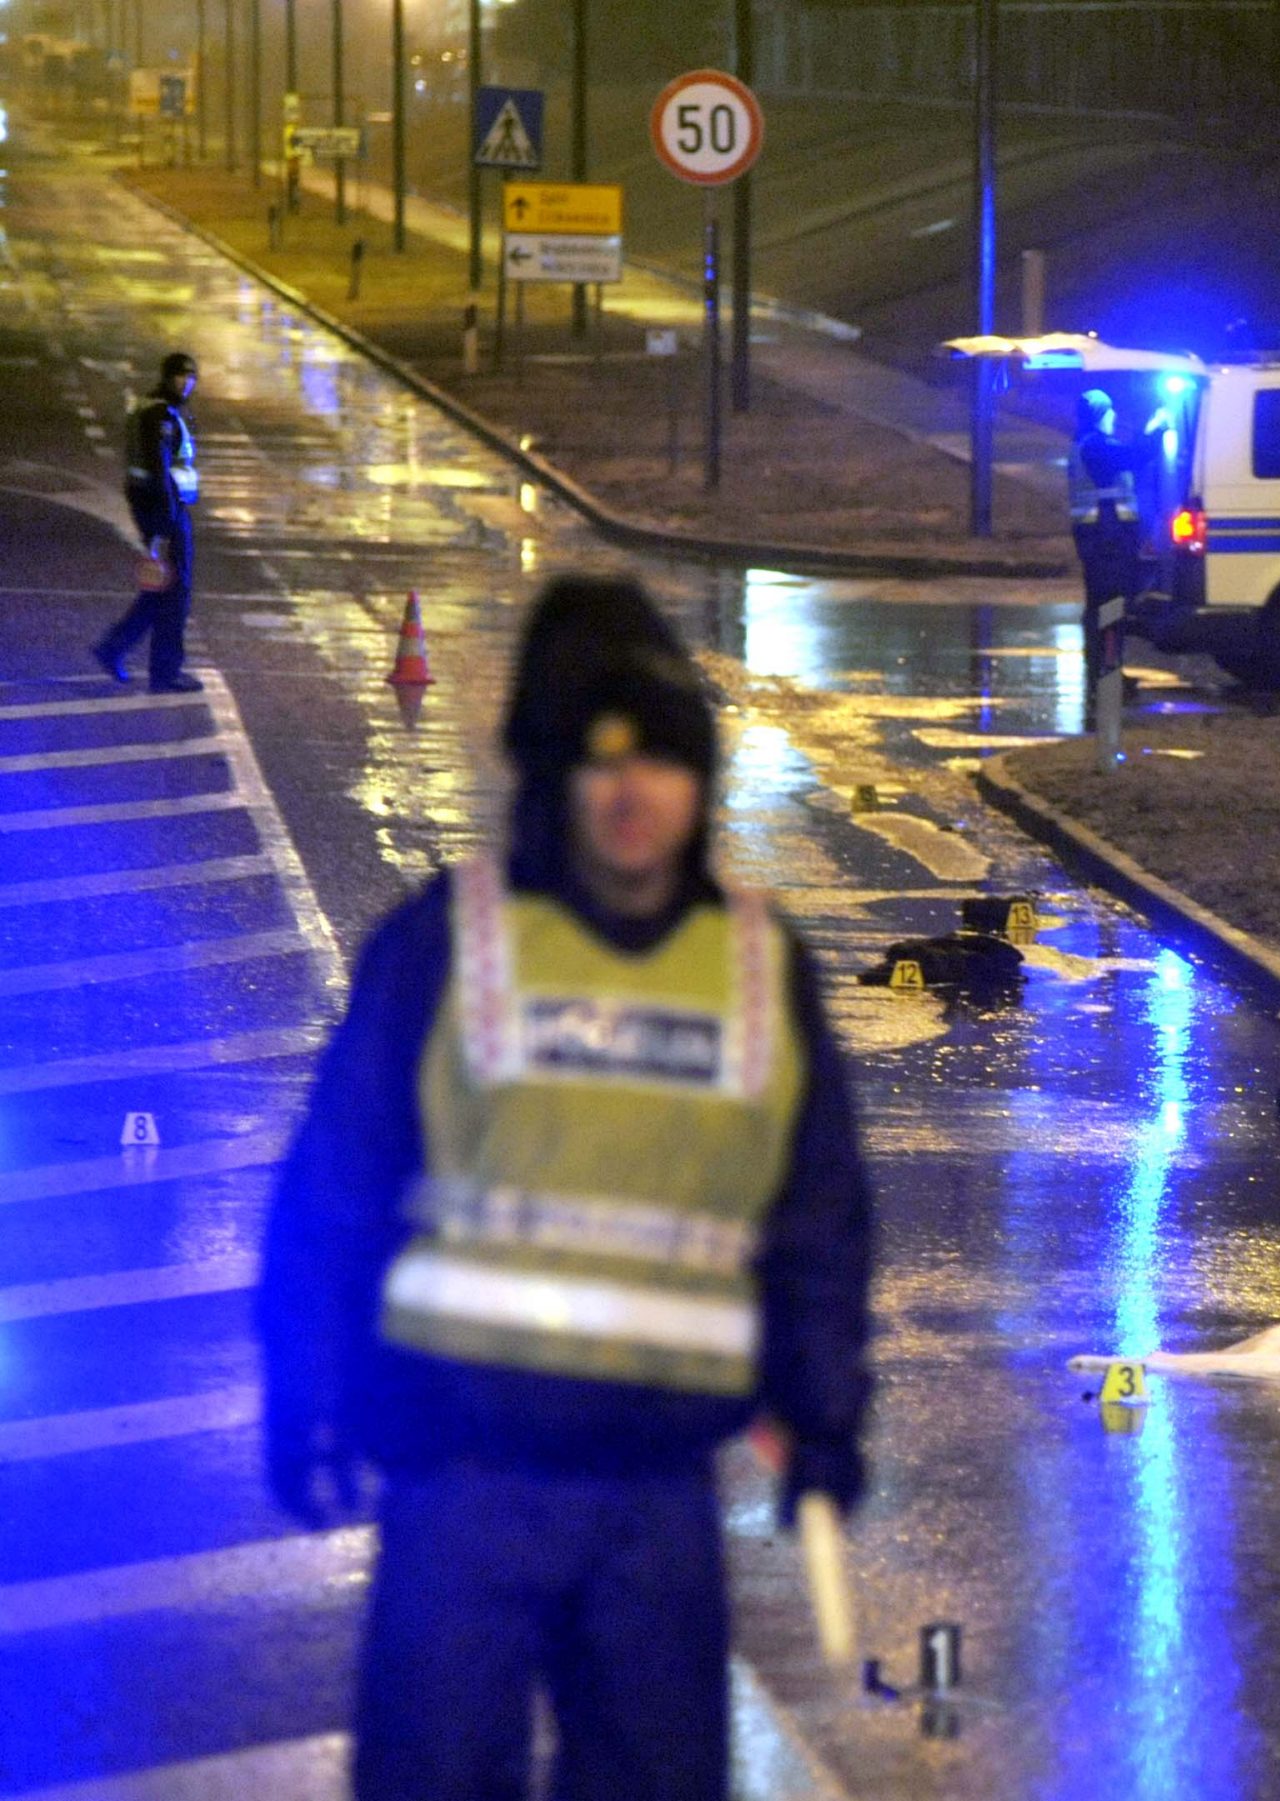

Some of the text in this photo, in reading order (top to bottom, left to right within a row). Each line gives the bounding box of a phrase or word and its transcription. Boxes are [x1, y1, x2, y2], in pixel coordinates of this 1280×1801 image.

[677, 104, 736, 155] 50
[1013, 906, 1030, 925] 13
[899, 963, 918, 984] 12
[134, 1115, 147, 1141] 8
[1118, 1366, 1135, 1397] 3
